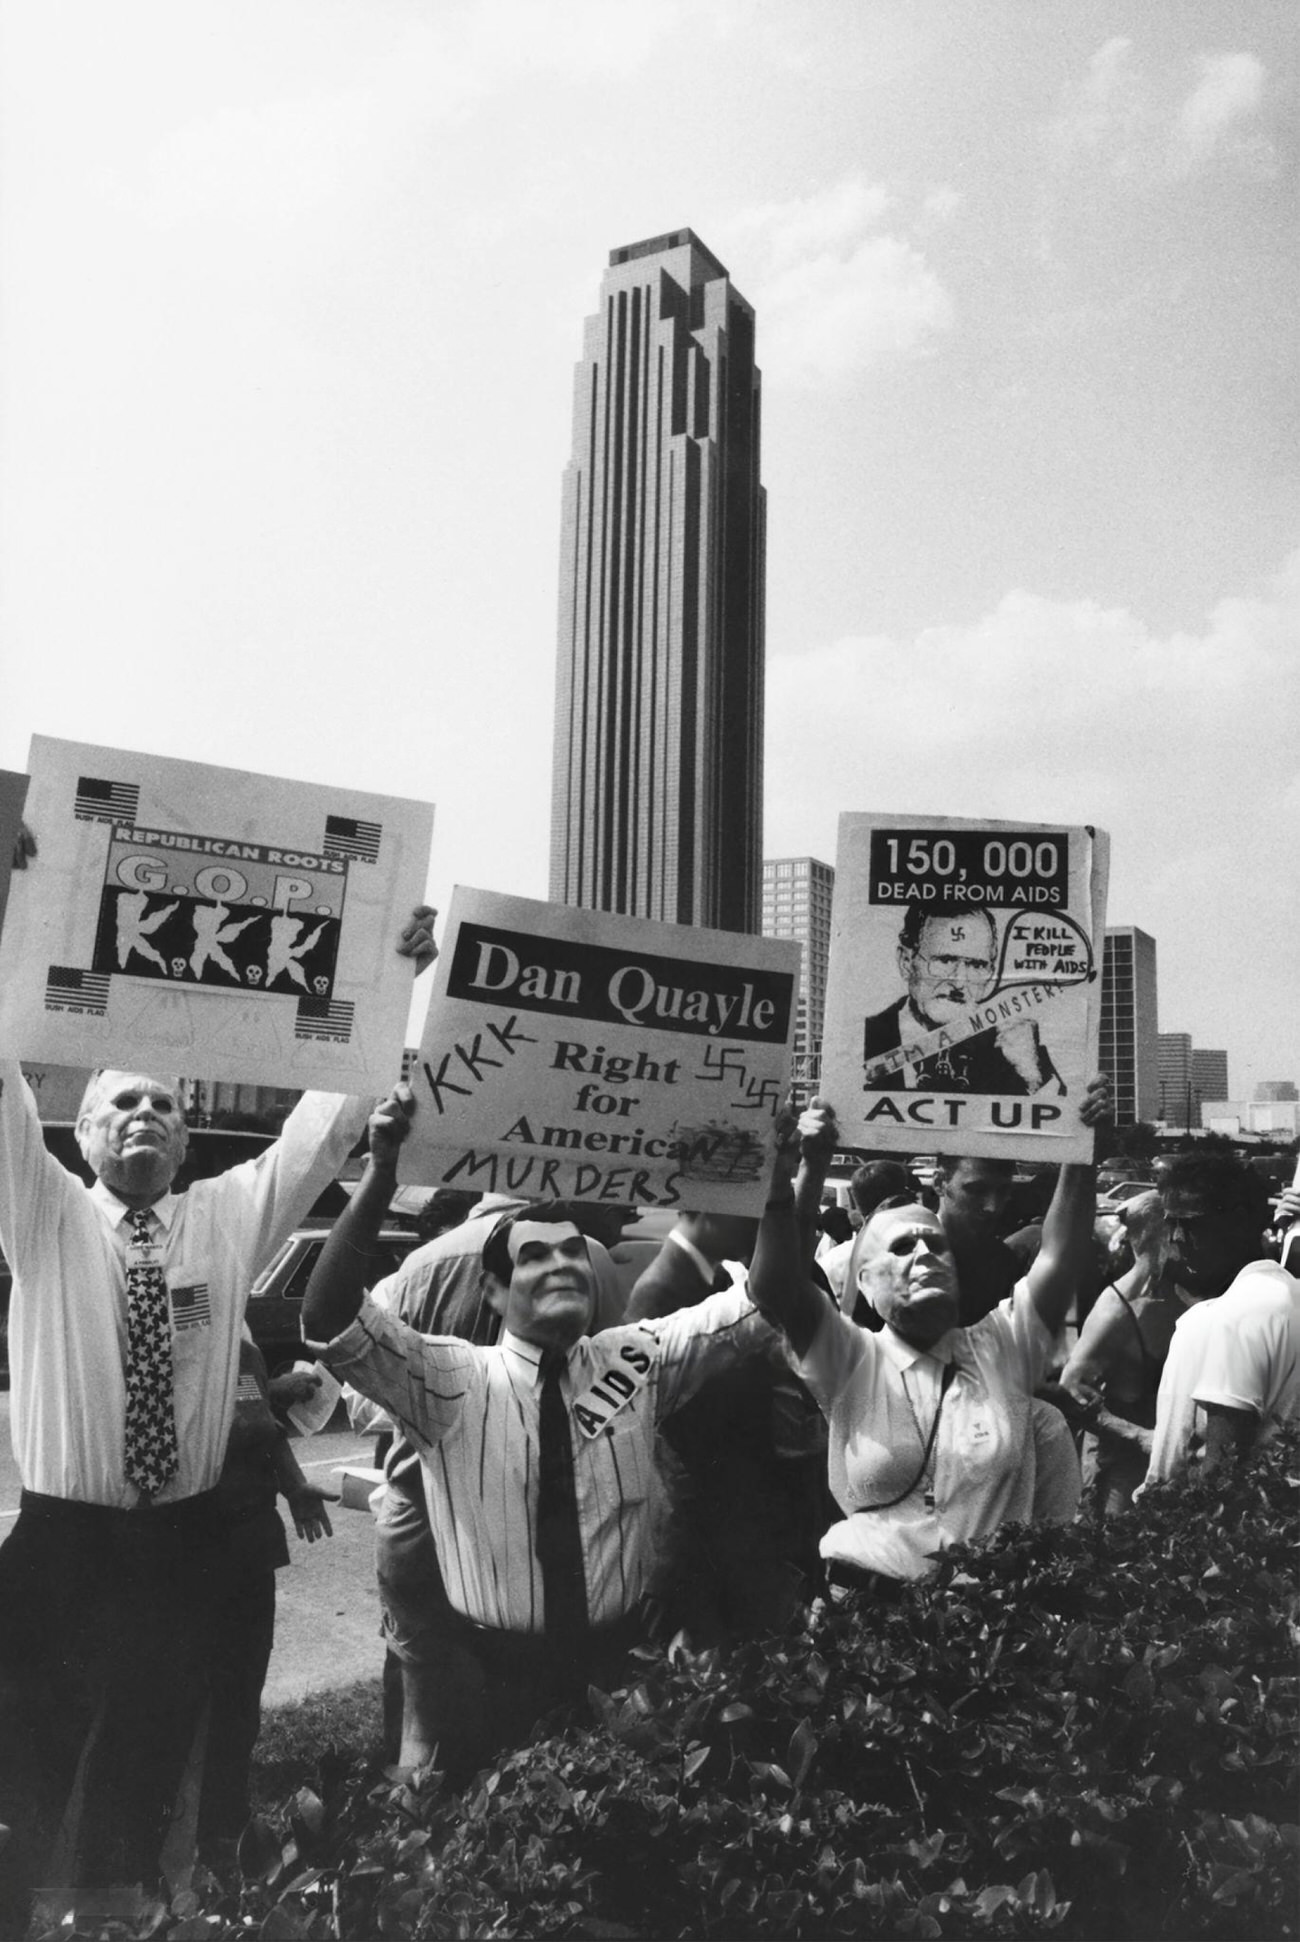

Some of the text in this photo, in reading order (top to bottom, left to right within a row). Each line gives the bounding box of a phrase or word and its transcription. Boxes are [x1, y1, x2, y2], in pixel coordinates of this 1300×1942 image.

[115, 827, 345, 873] REPUBLICAN ROOTS
[983, 840, 1059, 878] 000
[116, 854, 332, 915] G.O.P.
[877, 882, 1061, 903] DEAD FROM AIDS
[1012, 925, 1074, 941] I KILL
[1026, 942, 1077, 957] PEOPLE
[1013, 958, 1087, 974] WITH AIDS
[468, 940, 775, 1035] Dan Quayle
[549, 1040, 681, 1085] Right
[574, 1084, 640, 1117] for
[863, 1096, 1062, 1130] ACT UP
[442, 1149, 685, 1206] MURDERS
